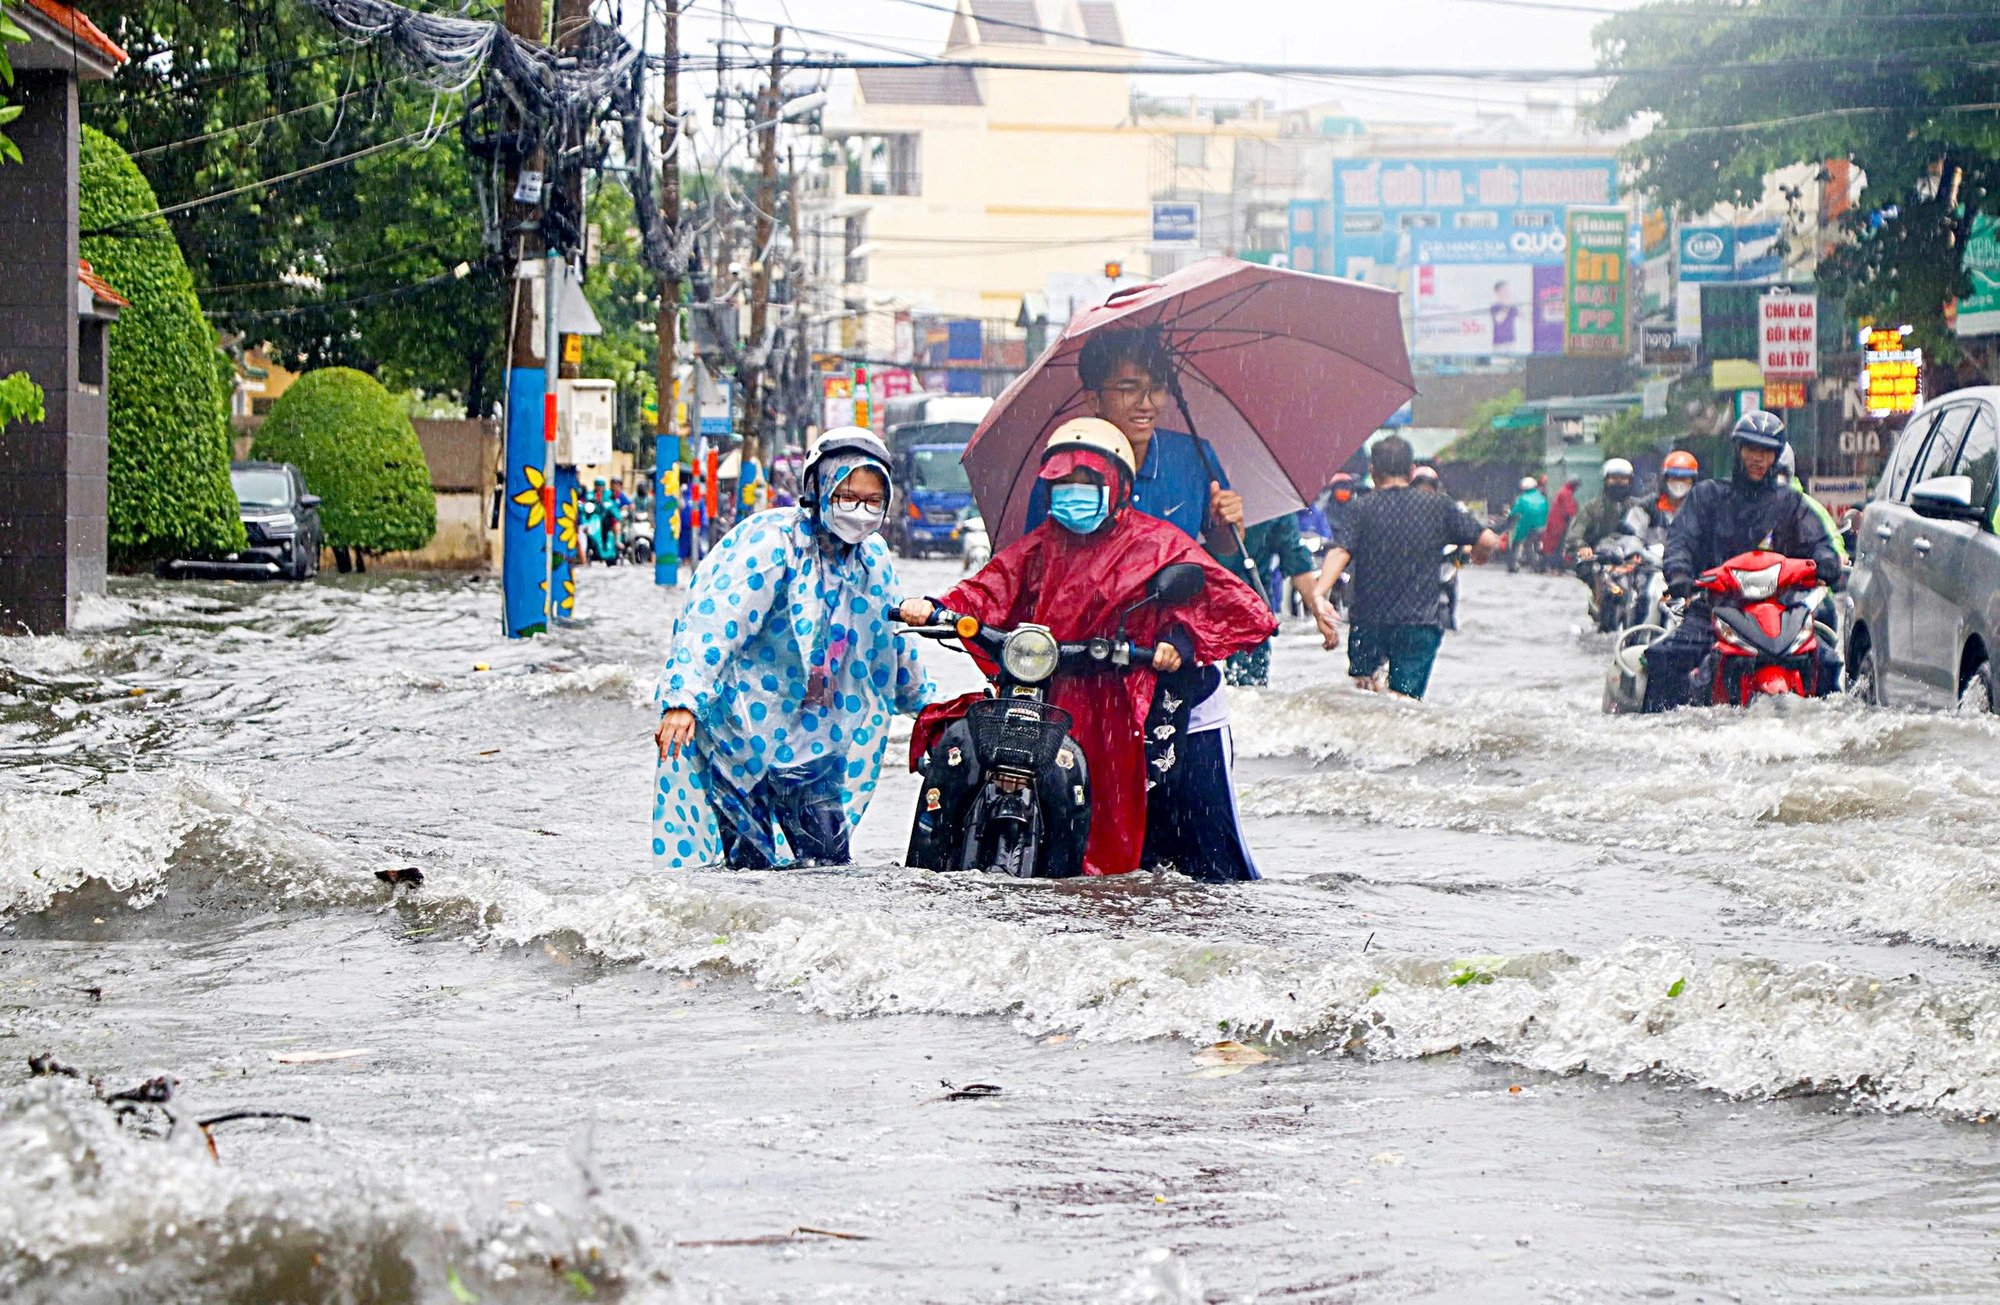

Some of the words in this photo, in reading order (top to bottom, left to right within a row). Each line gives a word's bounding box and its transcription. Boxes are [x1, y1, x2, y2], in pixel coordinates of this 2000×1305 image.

[1576, 249, 1619, 282] in
[1579, 309, 1614, 329] PP
[1798, 302, 1813, 318] GA
